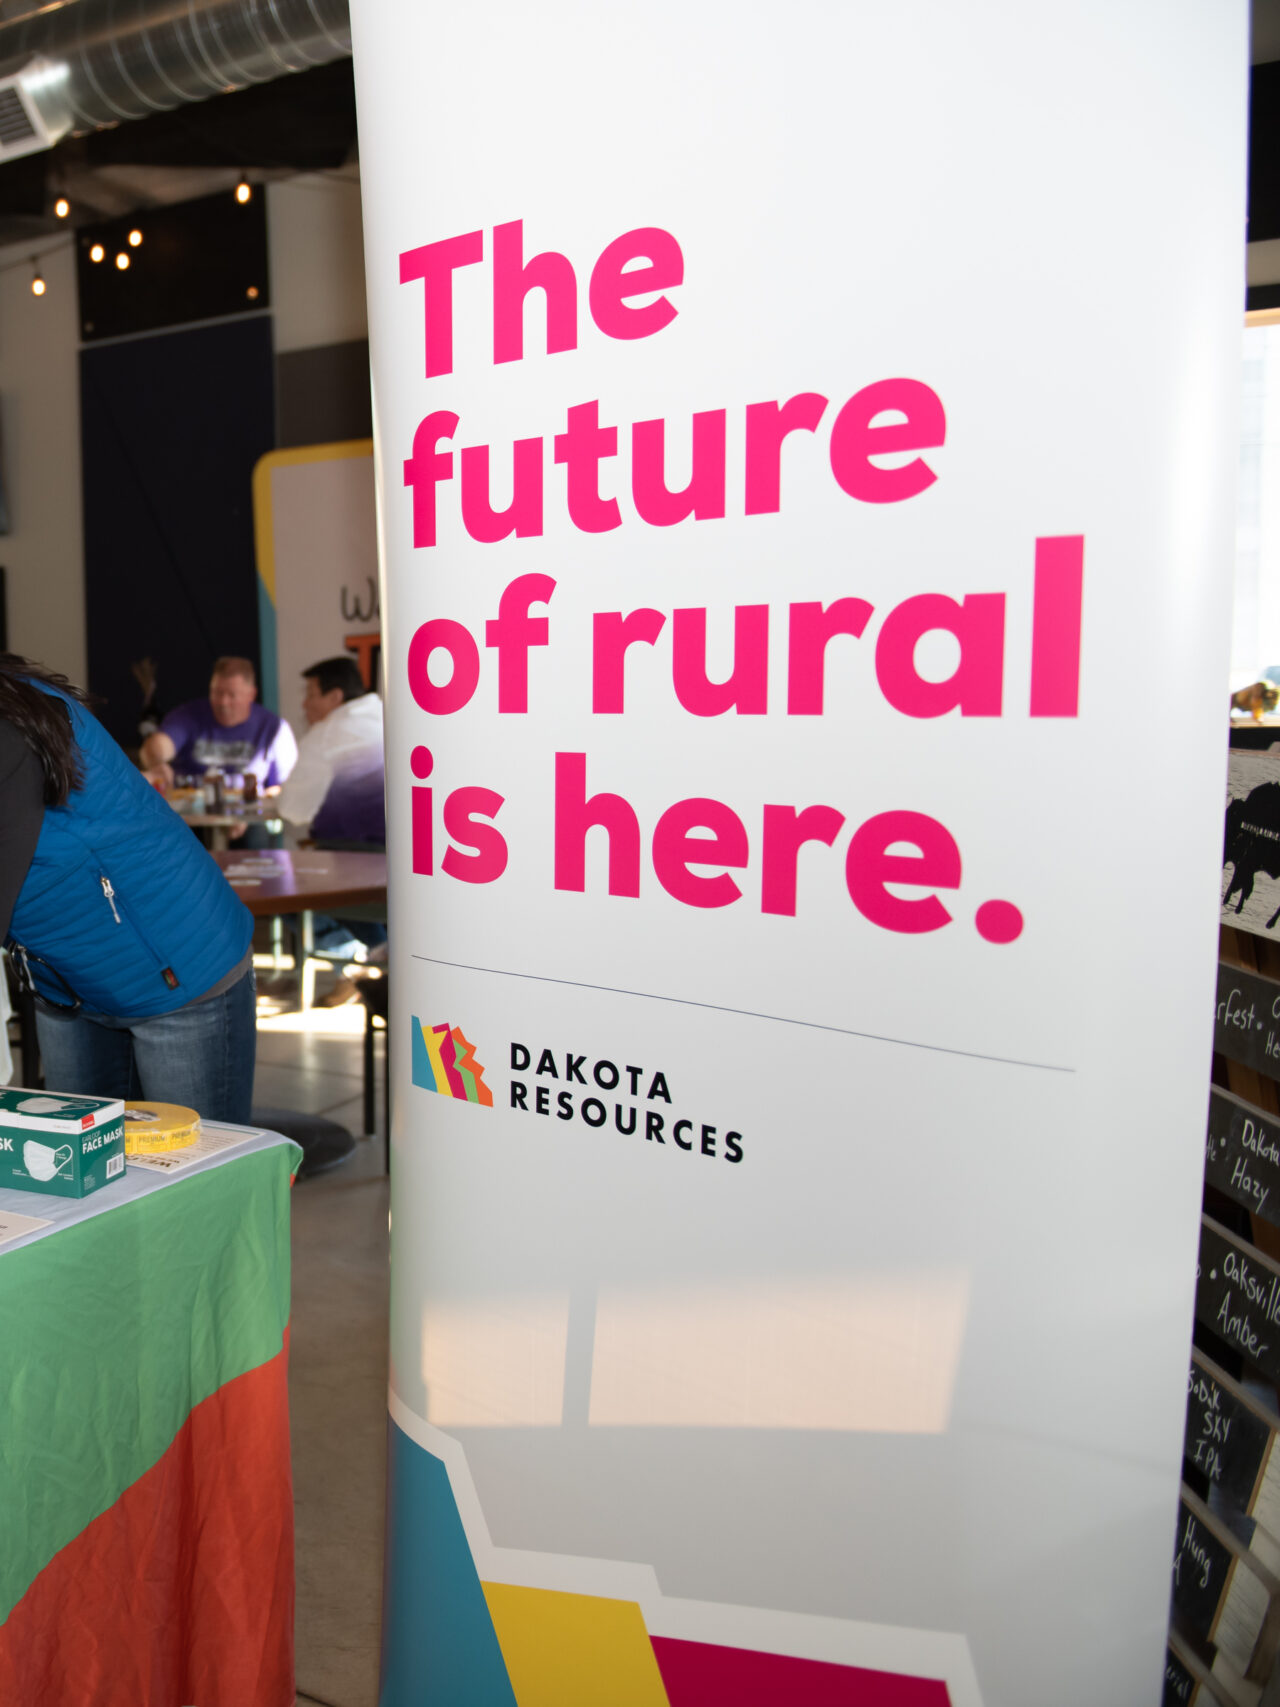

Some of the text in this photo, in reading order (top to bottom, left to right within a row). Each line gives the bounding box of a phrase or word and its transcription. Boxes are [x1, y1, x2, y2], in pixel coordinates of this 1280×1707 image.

[398, 218, 685, 379] The
[403, 377, 947, 549] future
[407, 534, 1085, 719] of rural
[410, 745, 1024, 945] is here.
[510, 1041, 672, 1104] DAKOTA
[82, 1136, 102, 1155] FACE
[103, 1126, 124, 1145] MASK
[510, 1080, 744, 1164] RESOURCES
[1230, 1156, 1270, 1215] Hazy
[1216, 1289, 1269, 1360] Amber
